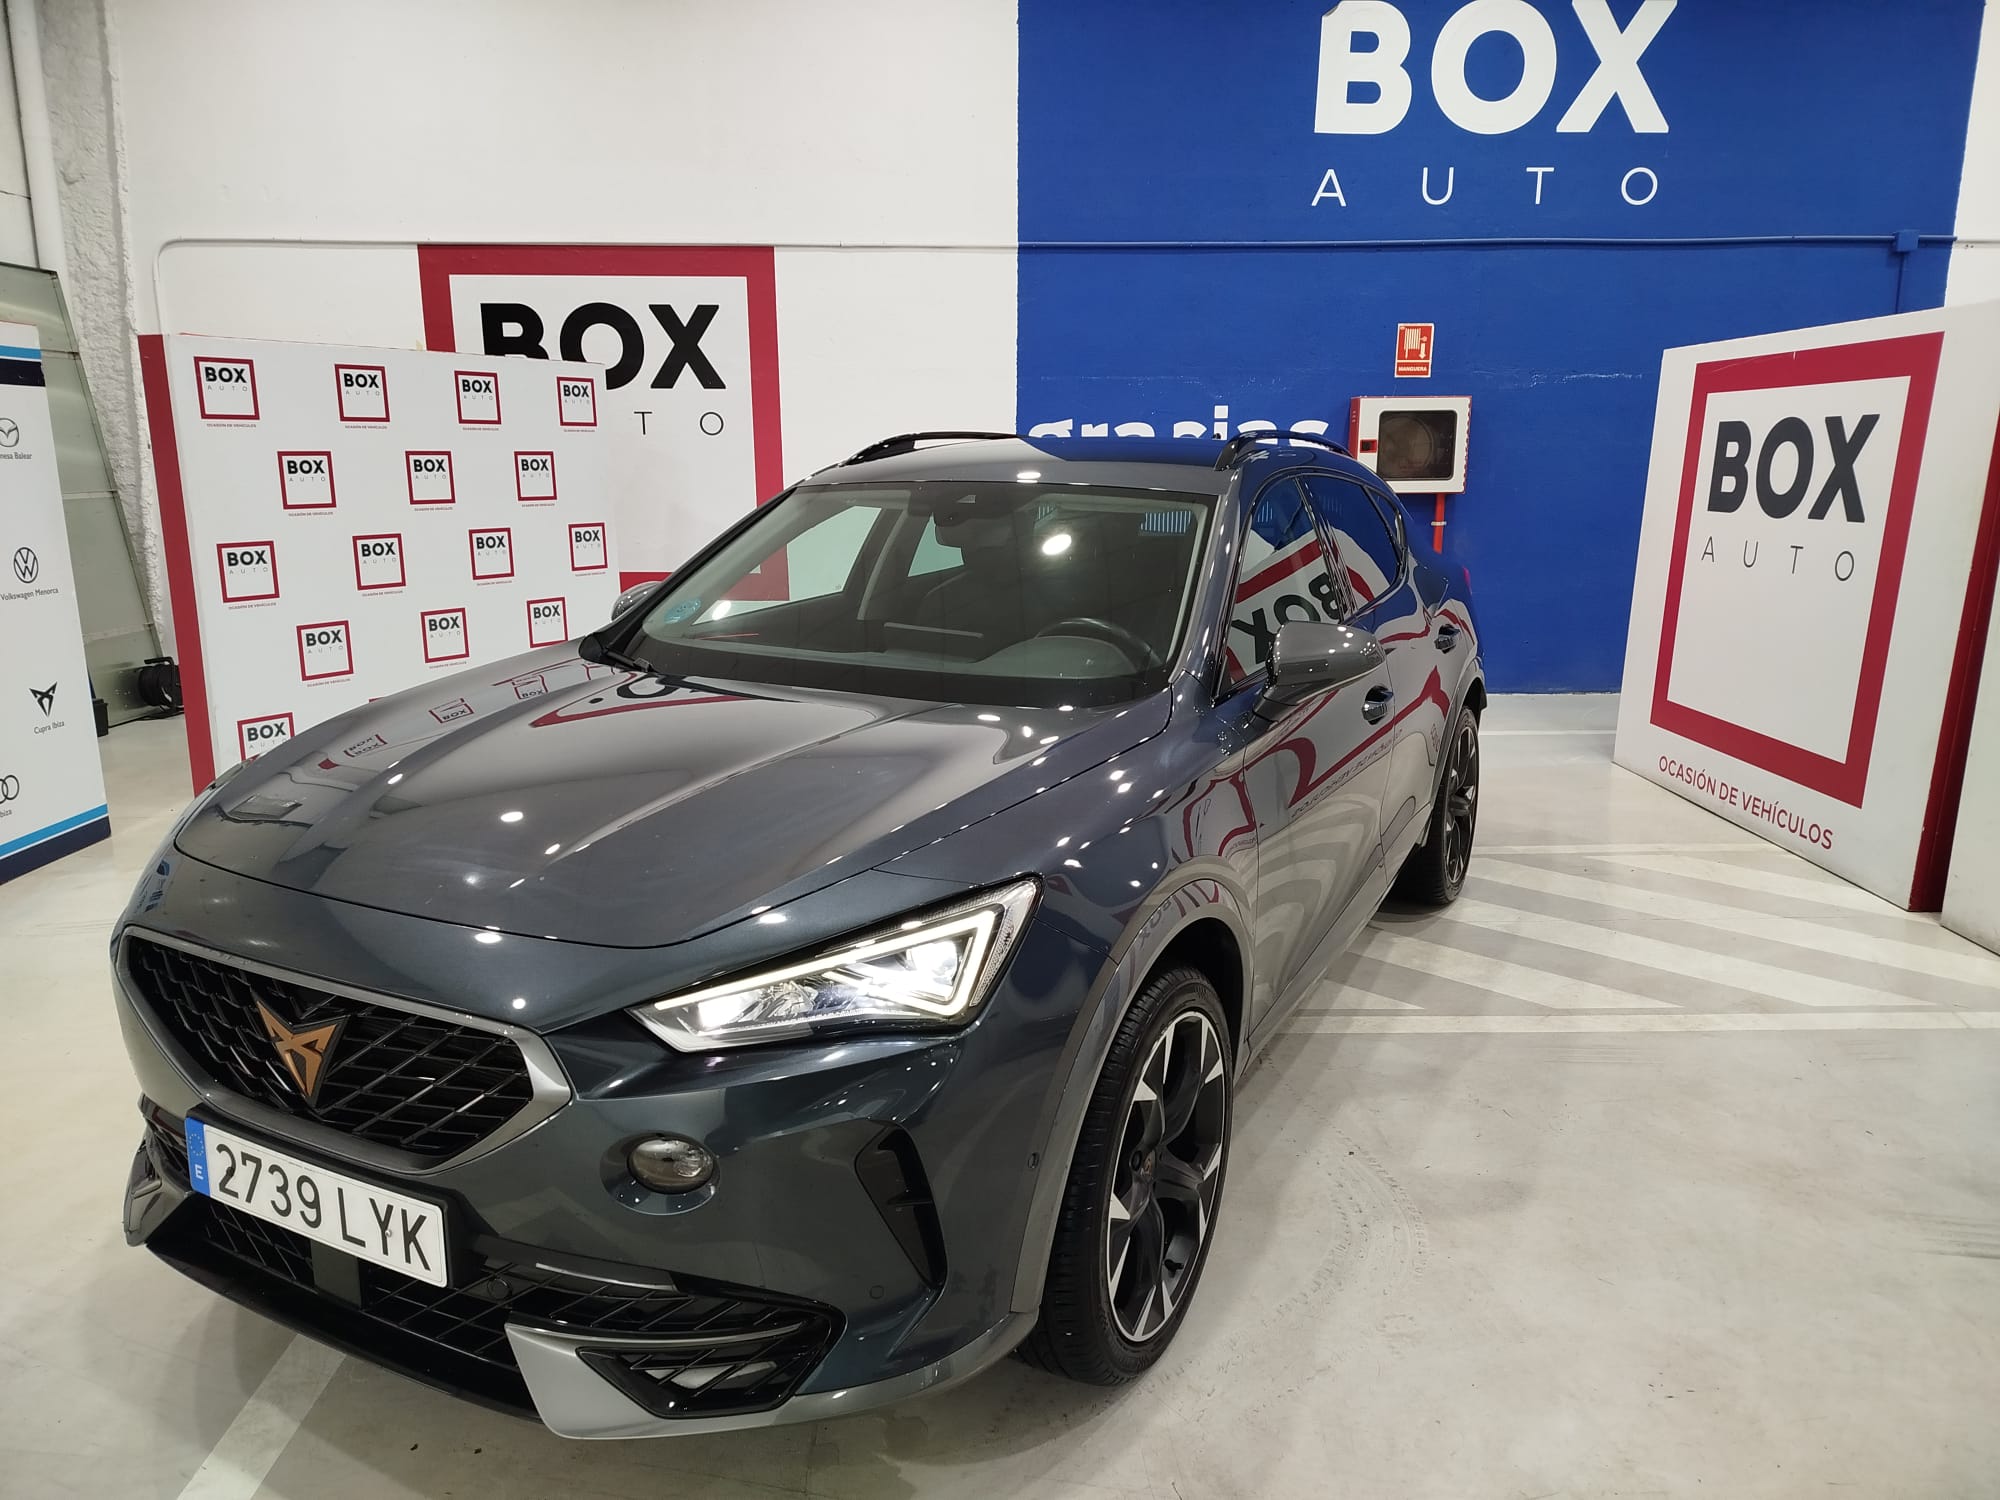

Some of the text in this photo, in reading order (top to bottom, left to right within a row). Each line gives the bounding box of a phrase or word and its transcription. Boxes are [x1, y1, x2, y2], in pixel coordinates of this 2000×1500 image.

[1314, 0, 1678, 134] BOX
[1312, 167, 1658, 206] AUTO
[480, 302, 726, 390] BOX
[205, 367, 246, 383] BOX
[344, 373, 379, 388] BOX
[462, 379, 492, 393] BOX
[563, 385, 589, 397] BOX
[287, 460, 325, 474] BOX
[413, 459, 446, 472] BOX
[521, 459, 548, 471] BOX
[1707, 413, 1880, 523] BOX
[476, 536, 505, 549] BOX
[575, 530, 600, 542] BOX
[361, 542, 395, 557] BOX
[227, 550, 267, 566] BOX
[1701, 536, 1855, 581] AUTO
[228, 566, 268, 574] AUTO
[0, 588, 59, 600] Volkswagen Menorca
[534, 605, 560, 619] BOX
[429, 616, 459, 631] BOX
[306, 630, 342, 646] BOX
[34, 720, 65, 734] Cupra Ibiza
[247, 722, 286, 741] BOX
[1658, 755, 1833, 850] OCASIÓN DE VEHÍCULOS
[194, 1164, 204, 1180] E
[216, 1143, 431, 1271] 2739 LYK
